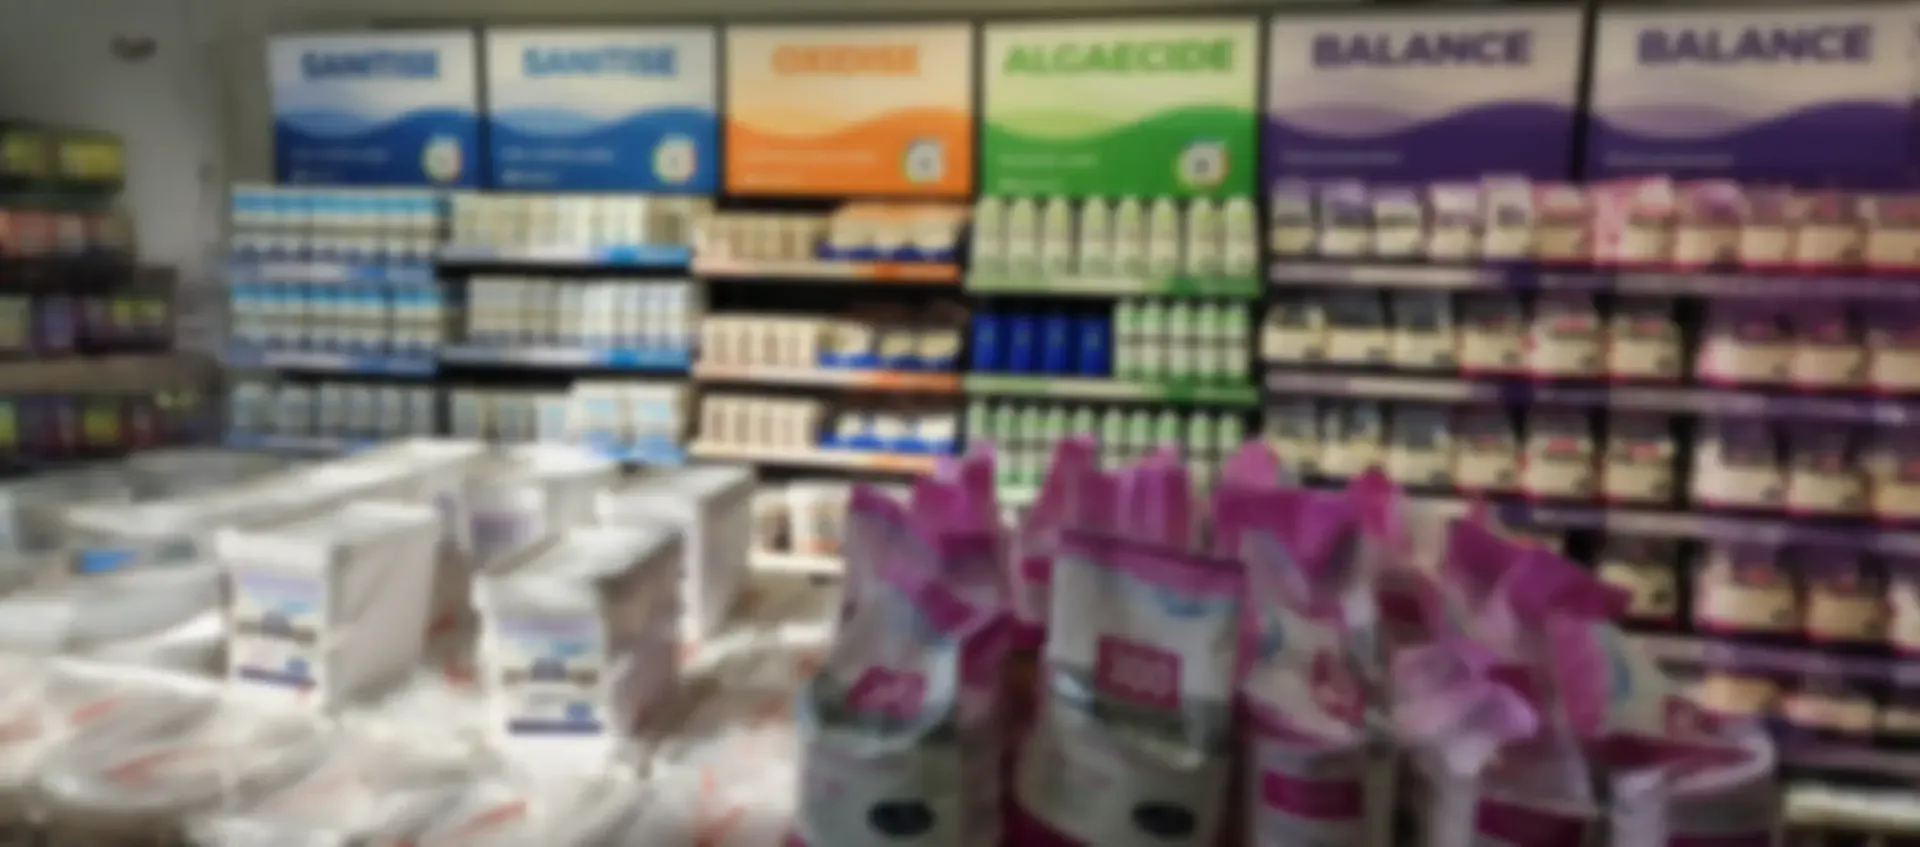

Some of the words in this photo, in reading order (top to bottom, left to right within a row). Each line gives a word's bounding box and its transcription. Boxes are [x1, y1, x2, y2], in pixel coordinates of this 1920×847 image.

[1004, 38, 1233, 73] ALGAECIDE
[1312, 30, 1531, 66] BALANCE
[1638, 25, 1873, 63] BALANCE
